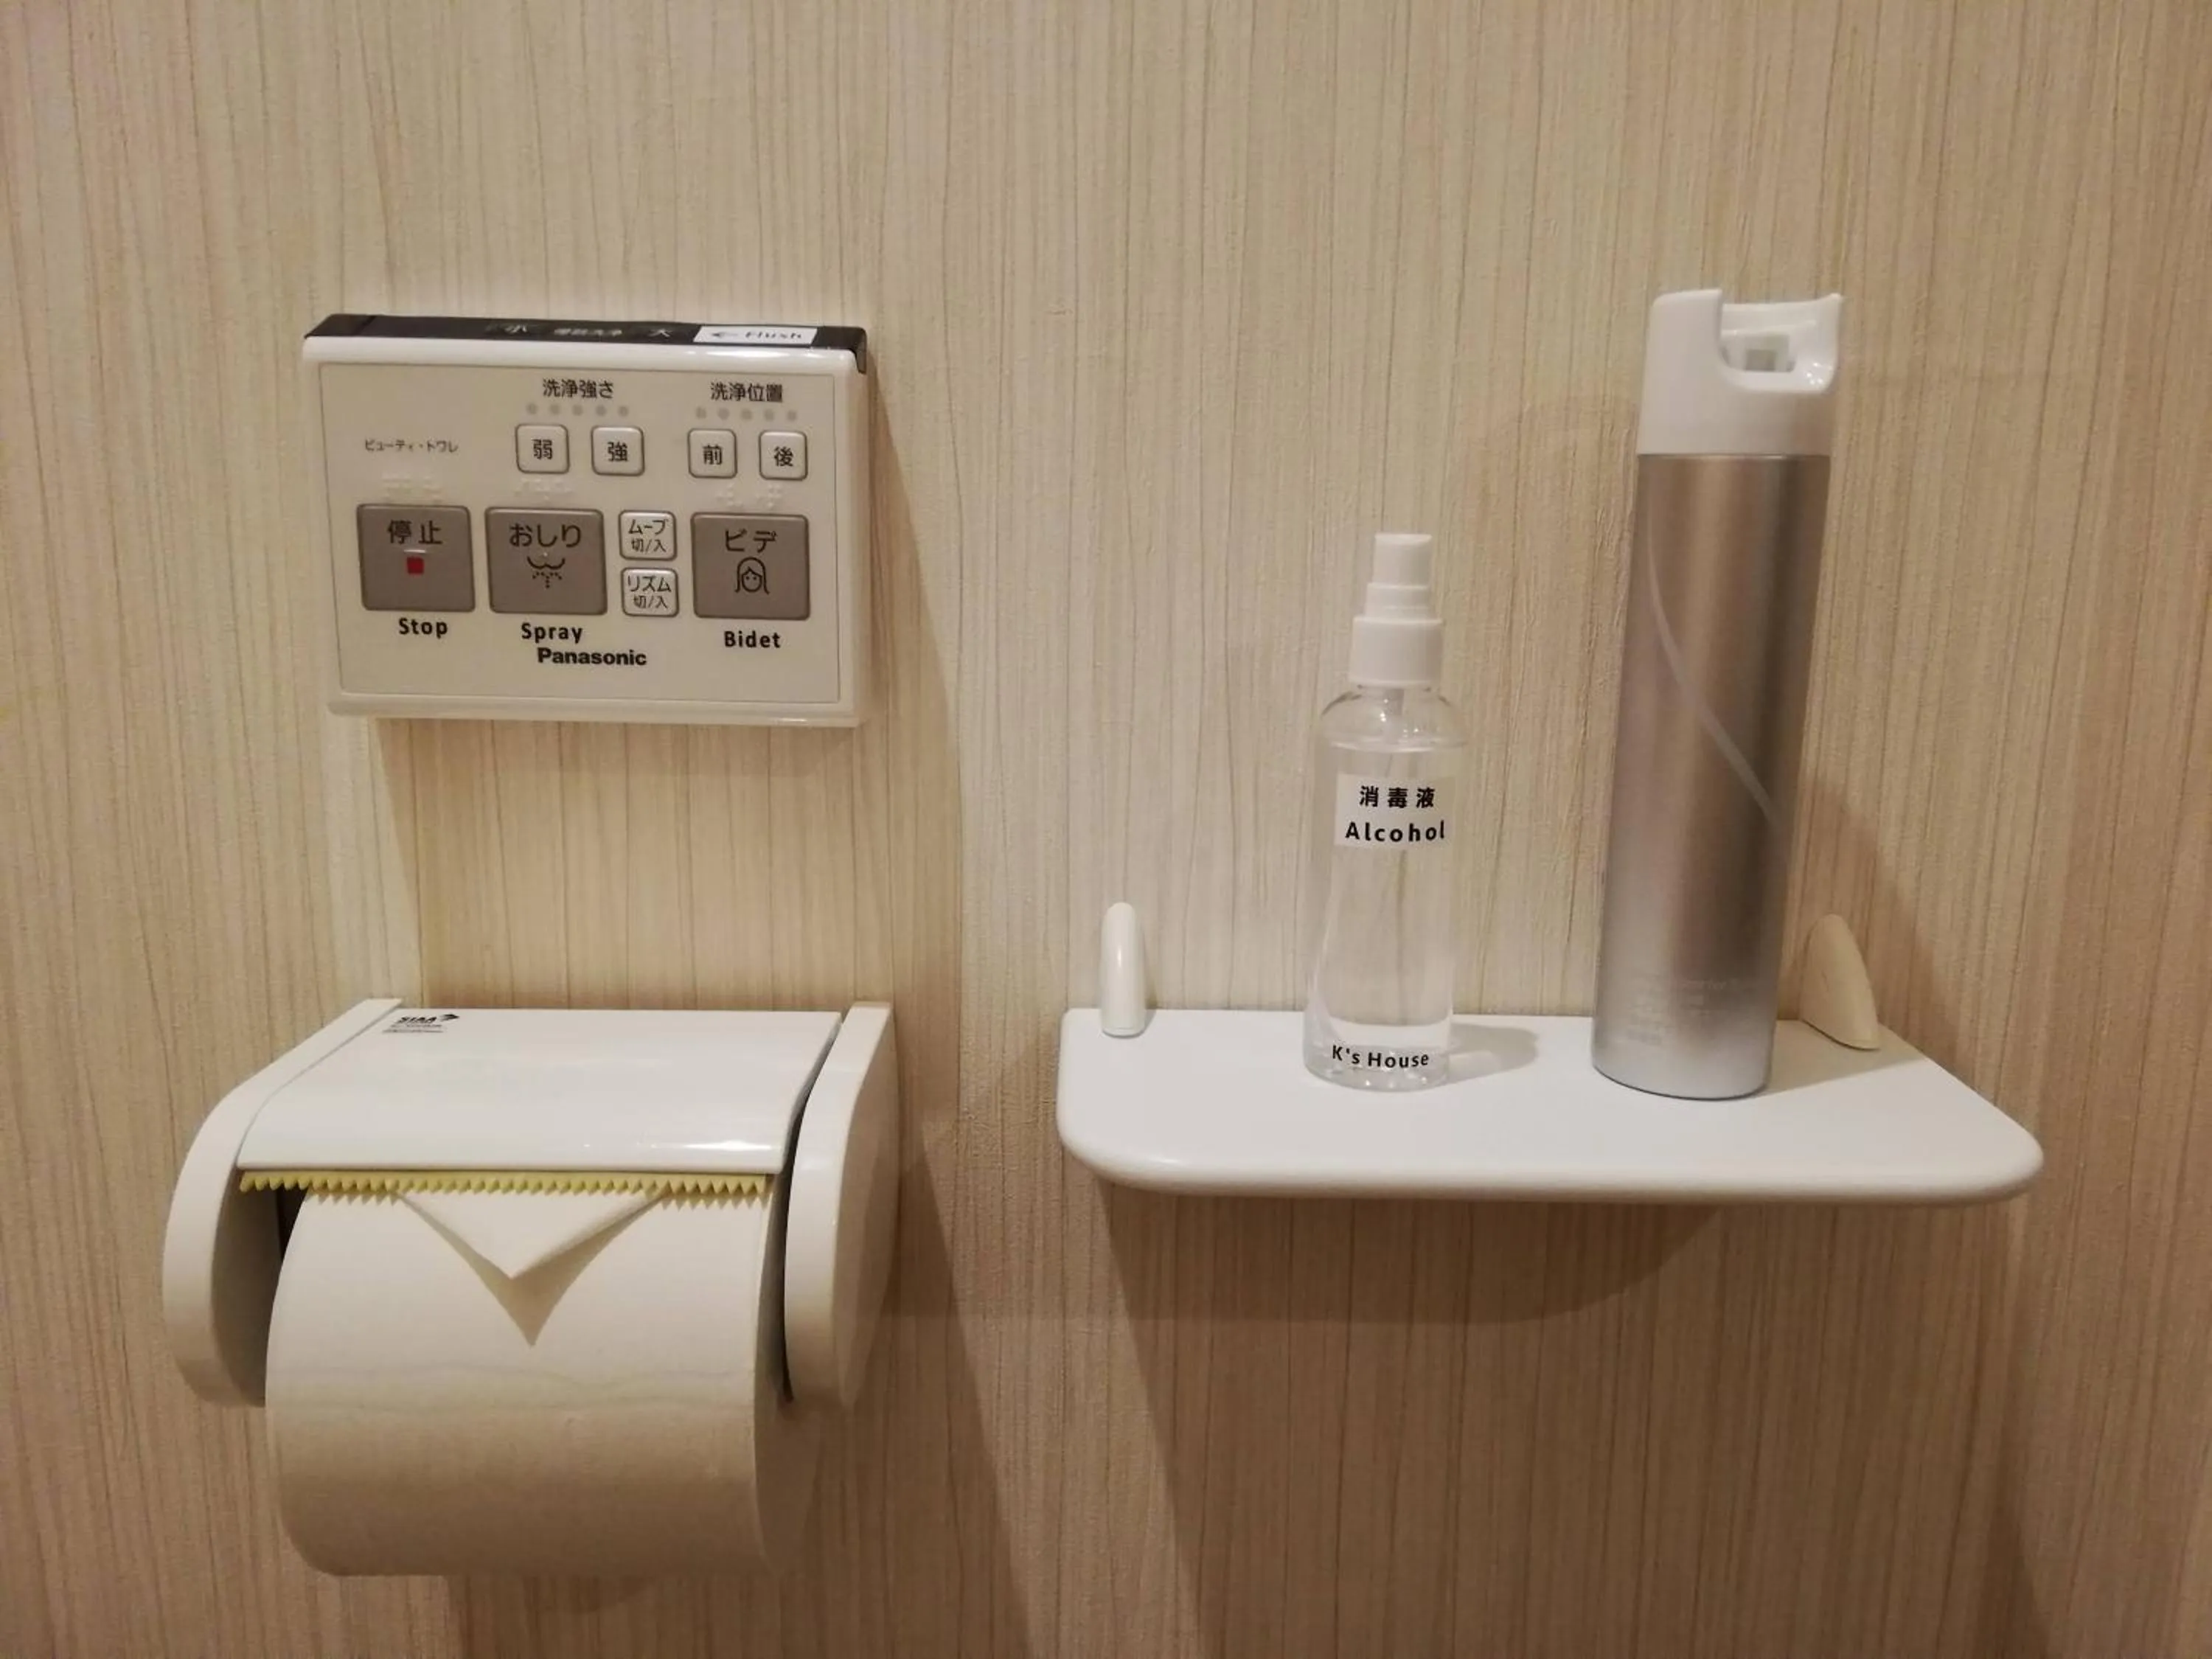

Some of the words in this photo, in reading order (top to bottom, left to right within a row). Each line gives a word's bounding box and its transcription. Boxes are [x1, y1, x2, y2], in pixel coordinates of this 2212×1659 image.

[543, 380, 614, 399] 洗浄強さ
[710, 383, 783, 403] 洗浄位置
[532, 439, 553, 460] 弱
[608, 442, 628, 462] 強
[703, 445, 723, 465] 前
[773, 447, 794, 467] 後
[387, 521, 443, 546] 停止
[509, 523, 582, 549] おしり
[725, 529, 778, 553] ビデ
[631, 539, 667, 553] 切/入
[627, 575, 671, 592] リズム
[633, 595, 668, 608] 切/入
[398, 617, 448, 637] Stop
[521, 623, 583, 644] Spray
[724, 630, 782, 649] Bidet
[537, 647, 647, 667] Panasonic
[1359, 785, 1436, 808] 消毒液
[1345, 820, 1446, 843] Alcohol
[1332, 1045, 1361, 1065] K's
[1367, 1052, 1430, 1068] House
